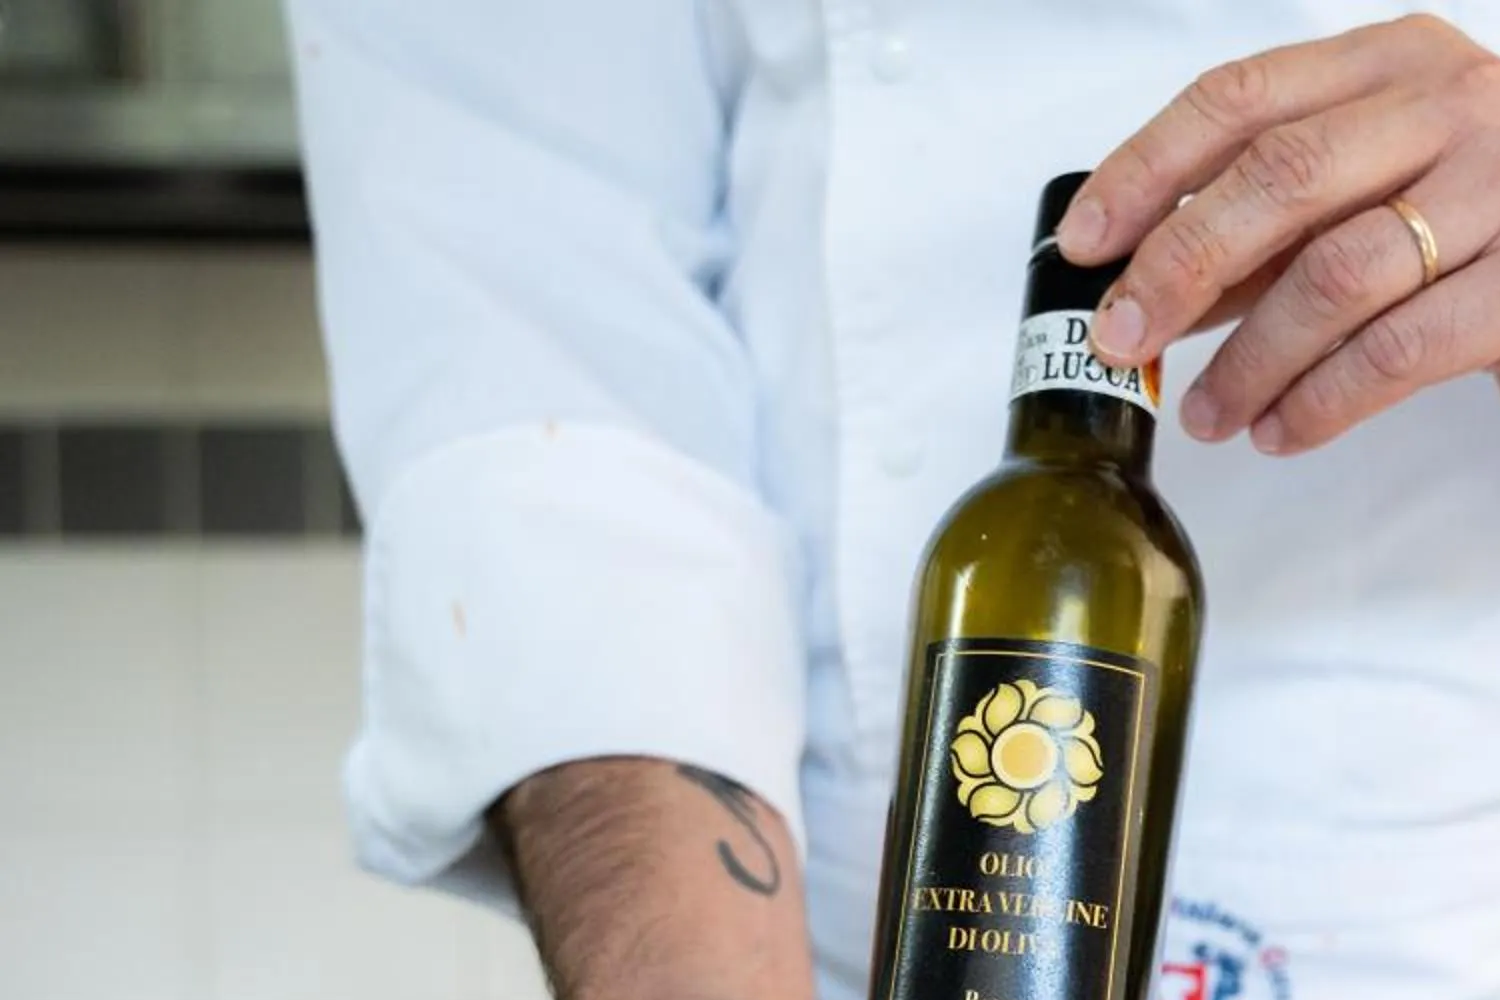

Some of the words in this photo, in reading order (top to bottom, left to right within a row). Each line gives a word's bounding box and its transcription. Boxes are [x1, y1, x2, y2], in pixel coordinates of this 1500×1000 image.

[1042, 351, 1141, 393] LUCCA
[979, 851, 1045, 879] OLIO
[912, 886, 992, 914] EXTRA
[998, 891, 1108, 929] VEINE
[948, 927, 977, 951] DI
[981, 929, 1057, 957] OLIV
